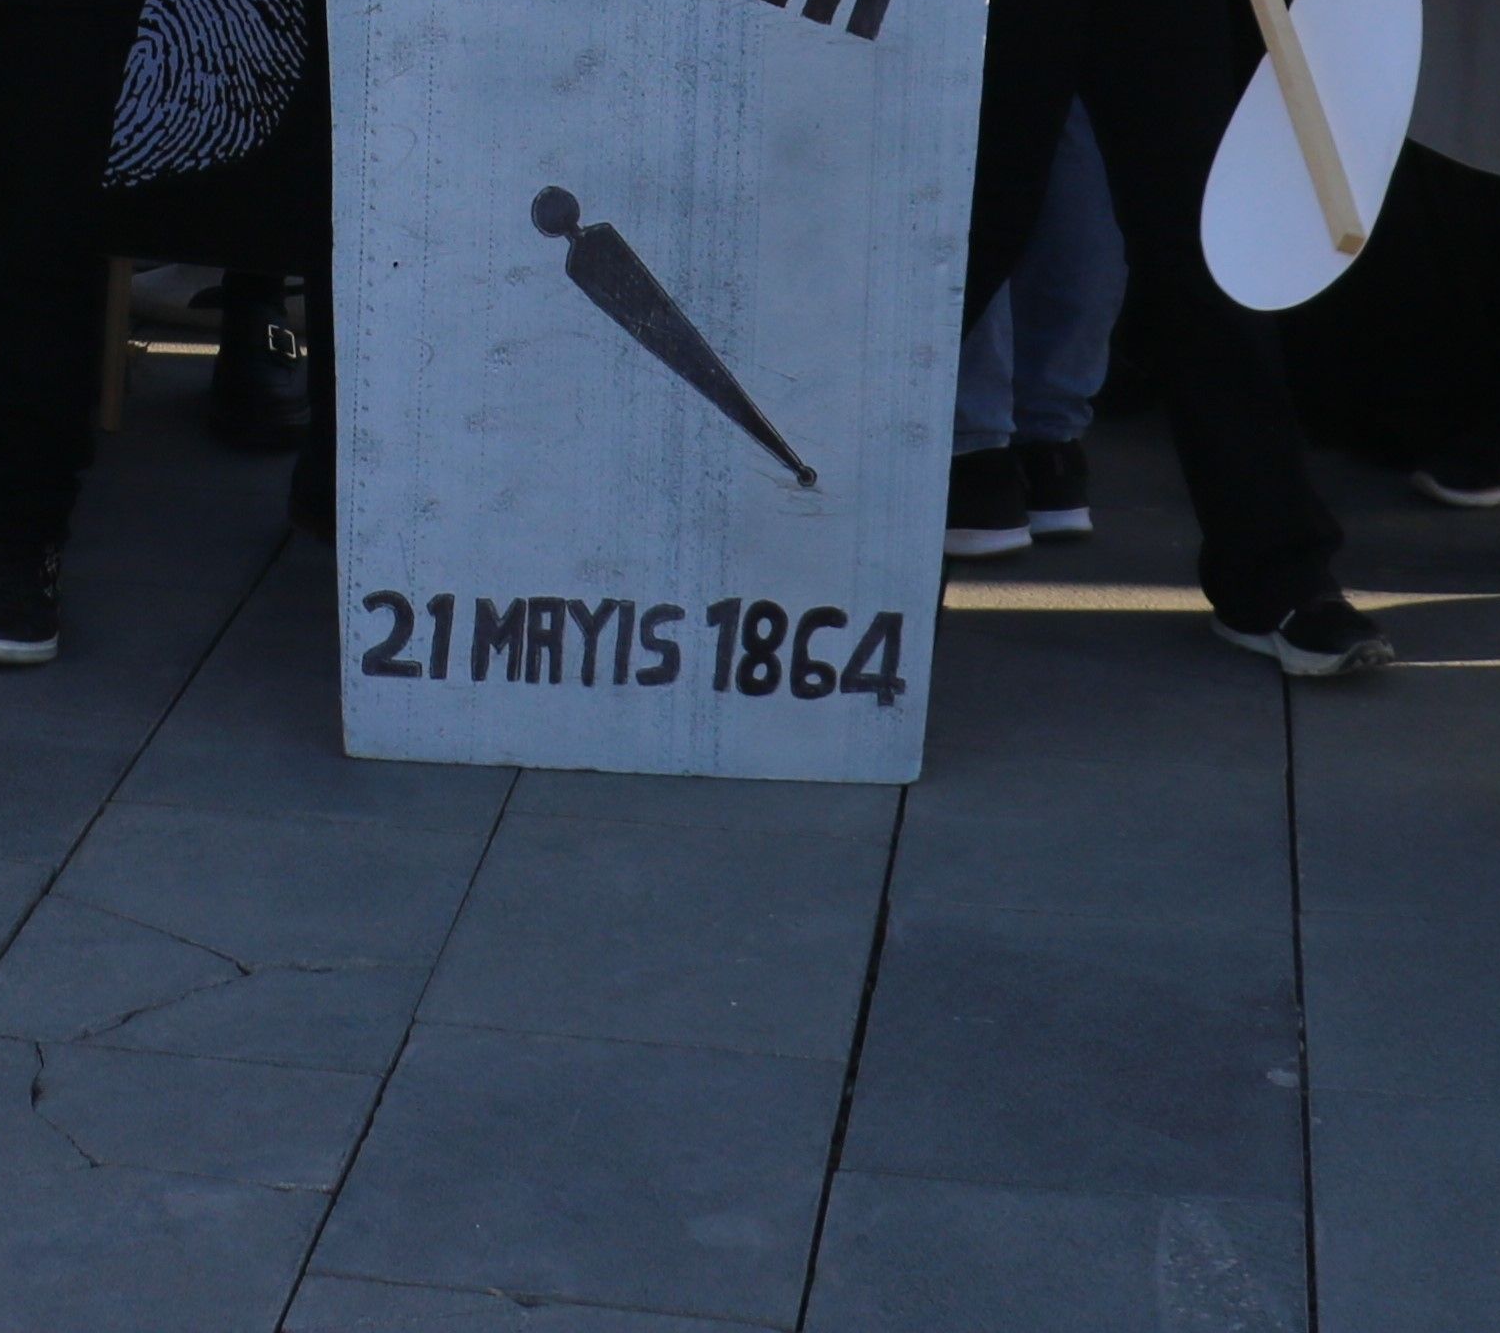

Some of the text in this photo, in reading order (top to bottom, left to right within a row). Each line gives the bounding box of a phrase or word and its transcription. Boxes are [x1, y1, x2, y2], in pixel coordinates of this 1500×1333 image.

[360, 588, 906, 708] 21 MAYIS 1864
